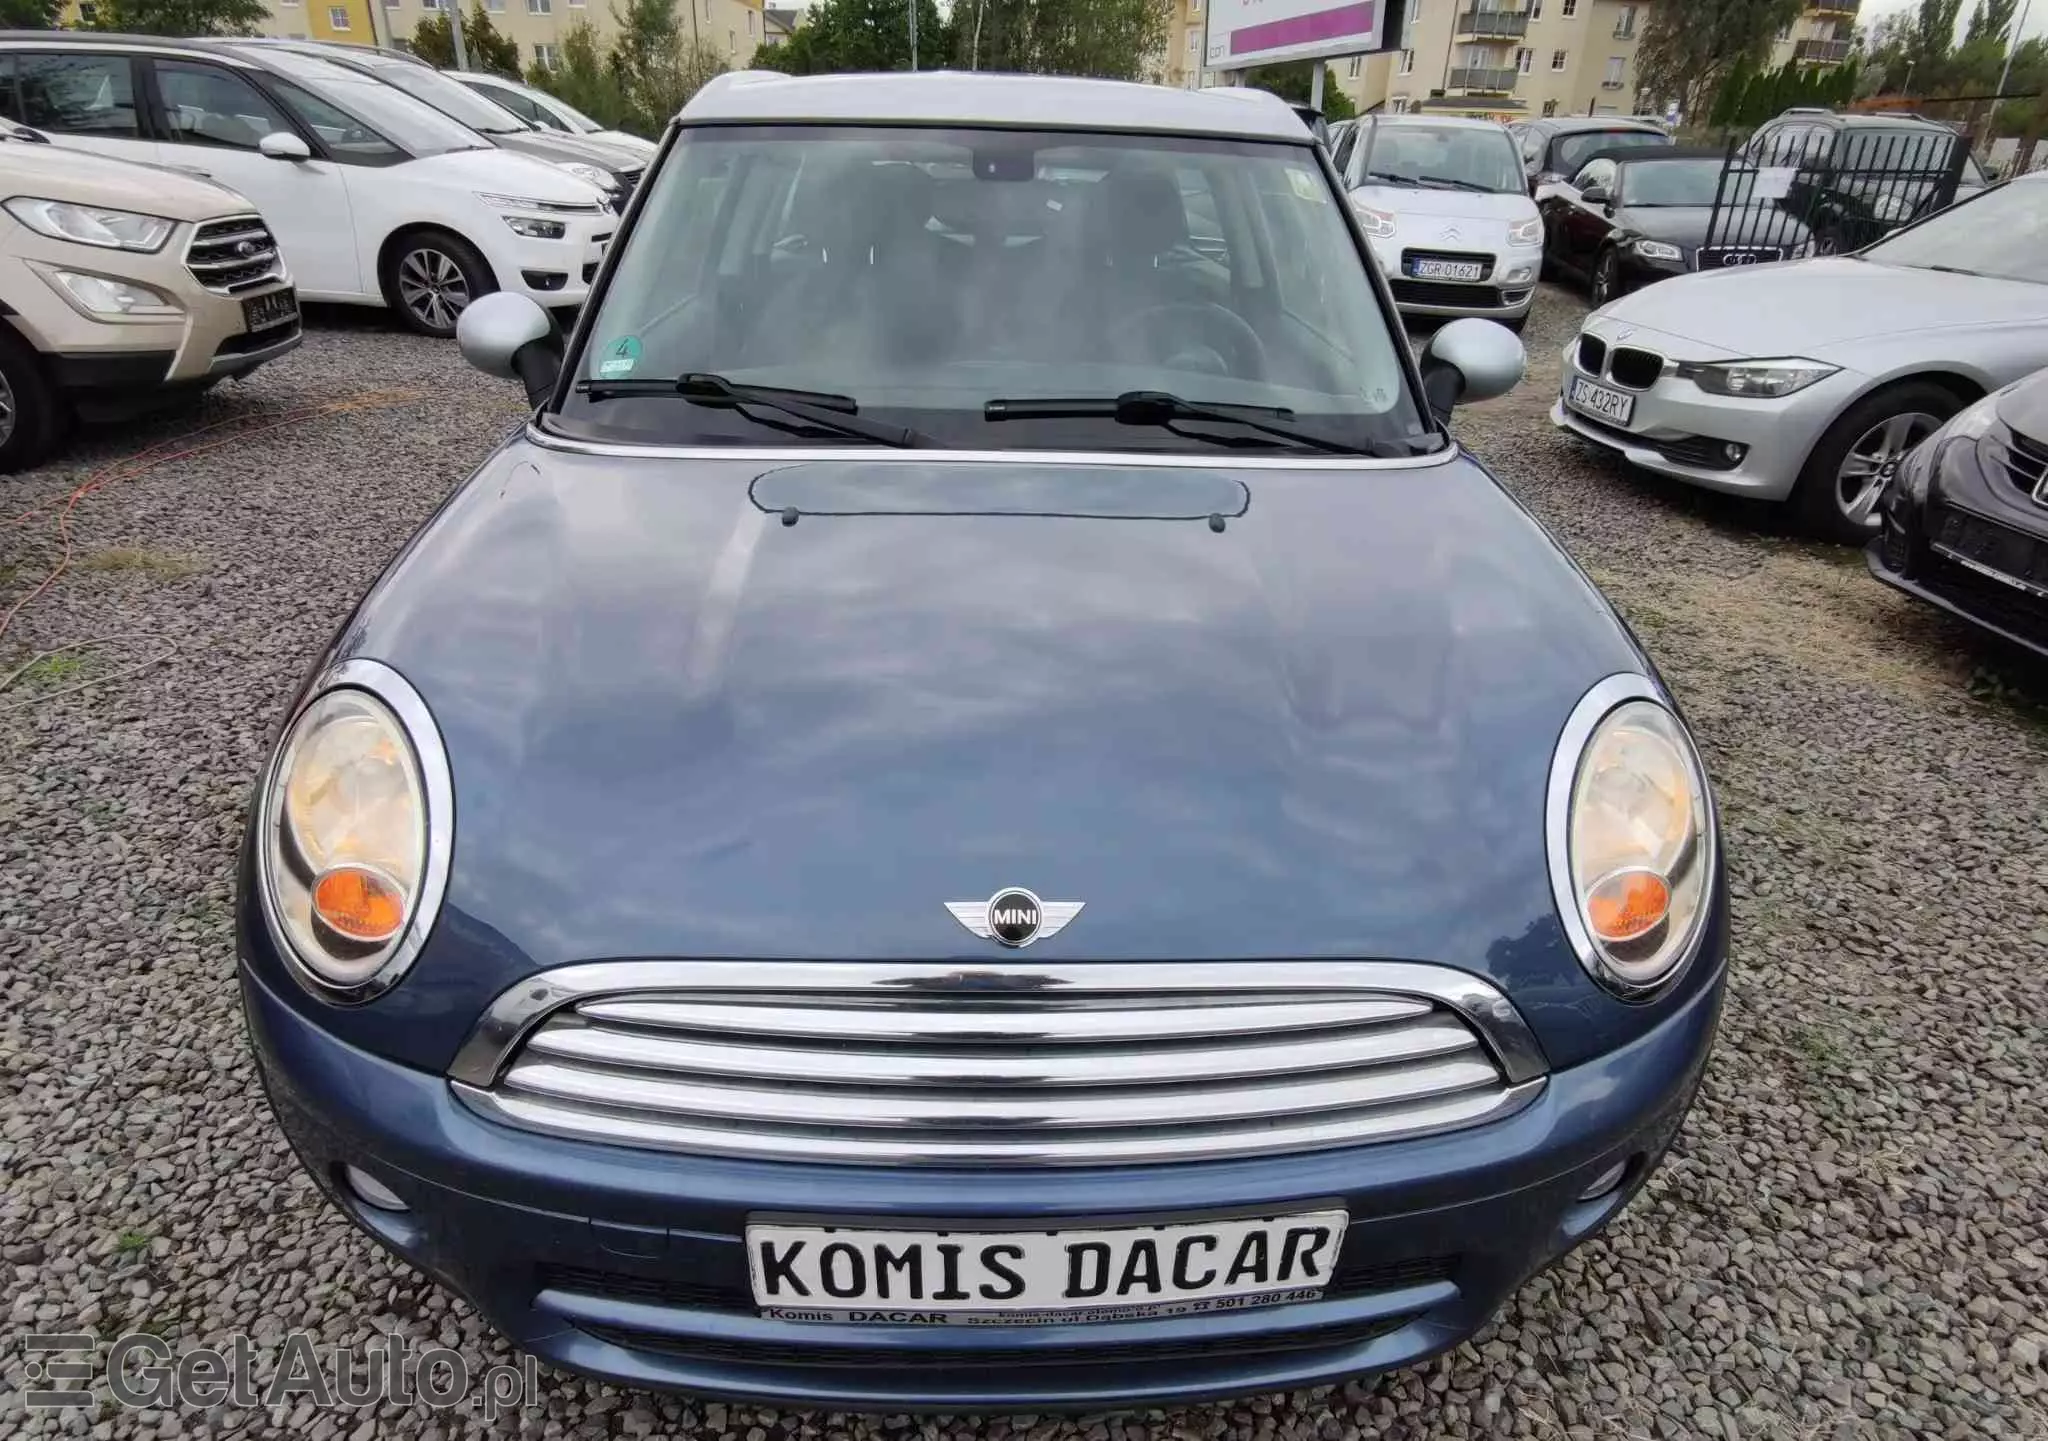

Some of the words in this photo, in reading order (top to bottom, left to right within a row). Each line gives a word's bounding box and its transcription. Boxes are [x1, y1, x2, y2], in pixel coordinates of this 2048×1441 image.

[1421, 262, 1441, 274] ZGR
[616, 338, 628, 358] 4
[1576, 382, 1589, 403] ZS
[1591, 389, 1628, 417] 432RY
[994, 909, 1037, 925] MINI
[760, 1240, 1026, 1300] KOMIS
[1064, 1226, 1331, 1298] DACAR
[770, 1308, 833, 1321] Komis
[849, 1311, 948, 1323] DACAR
[968, 1317, 1055, 1325] Szczecin
[1216, 1298, 1245, 1309] 501
[1252, 1294, 1281, 1305] 280
